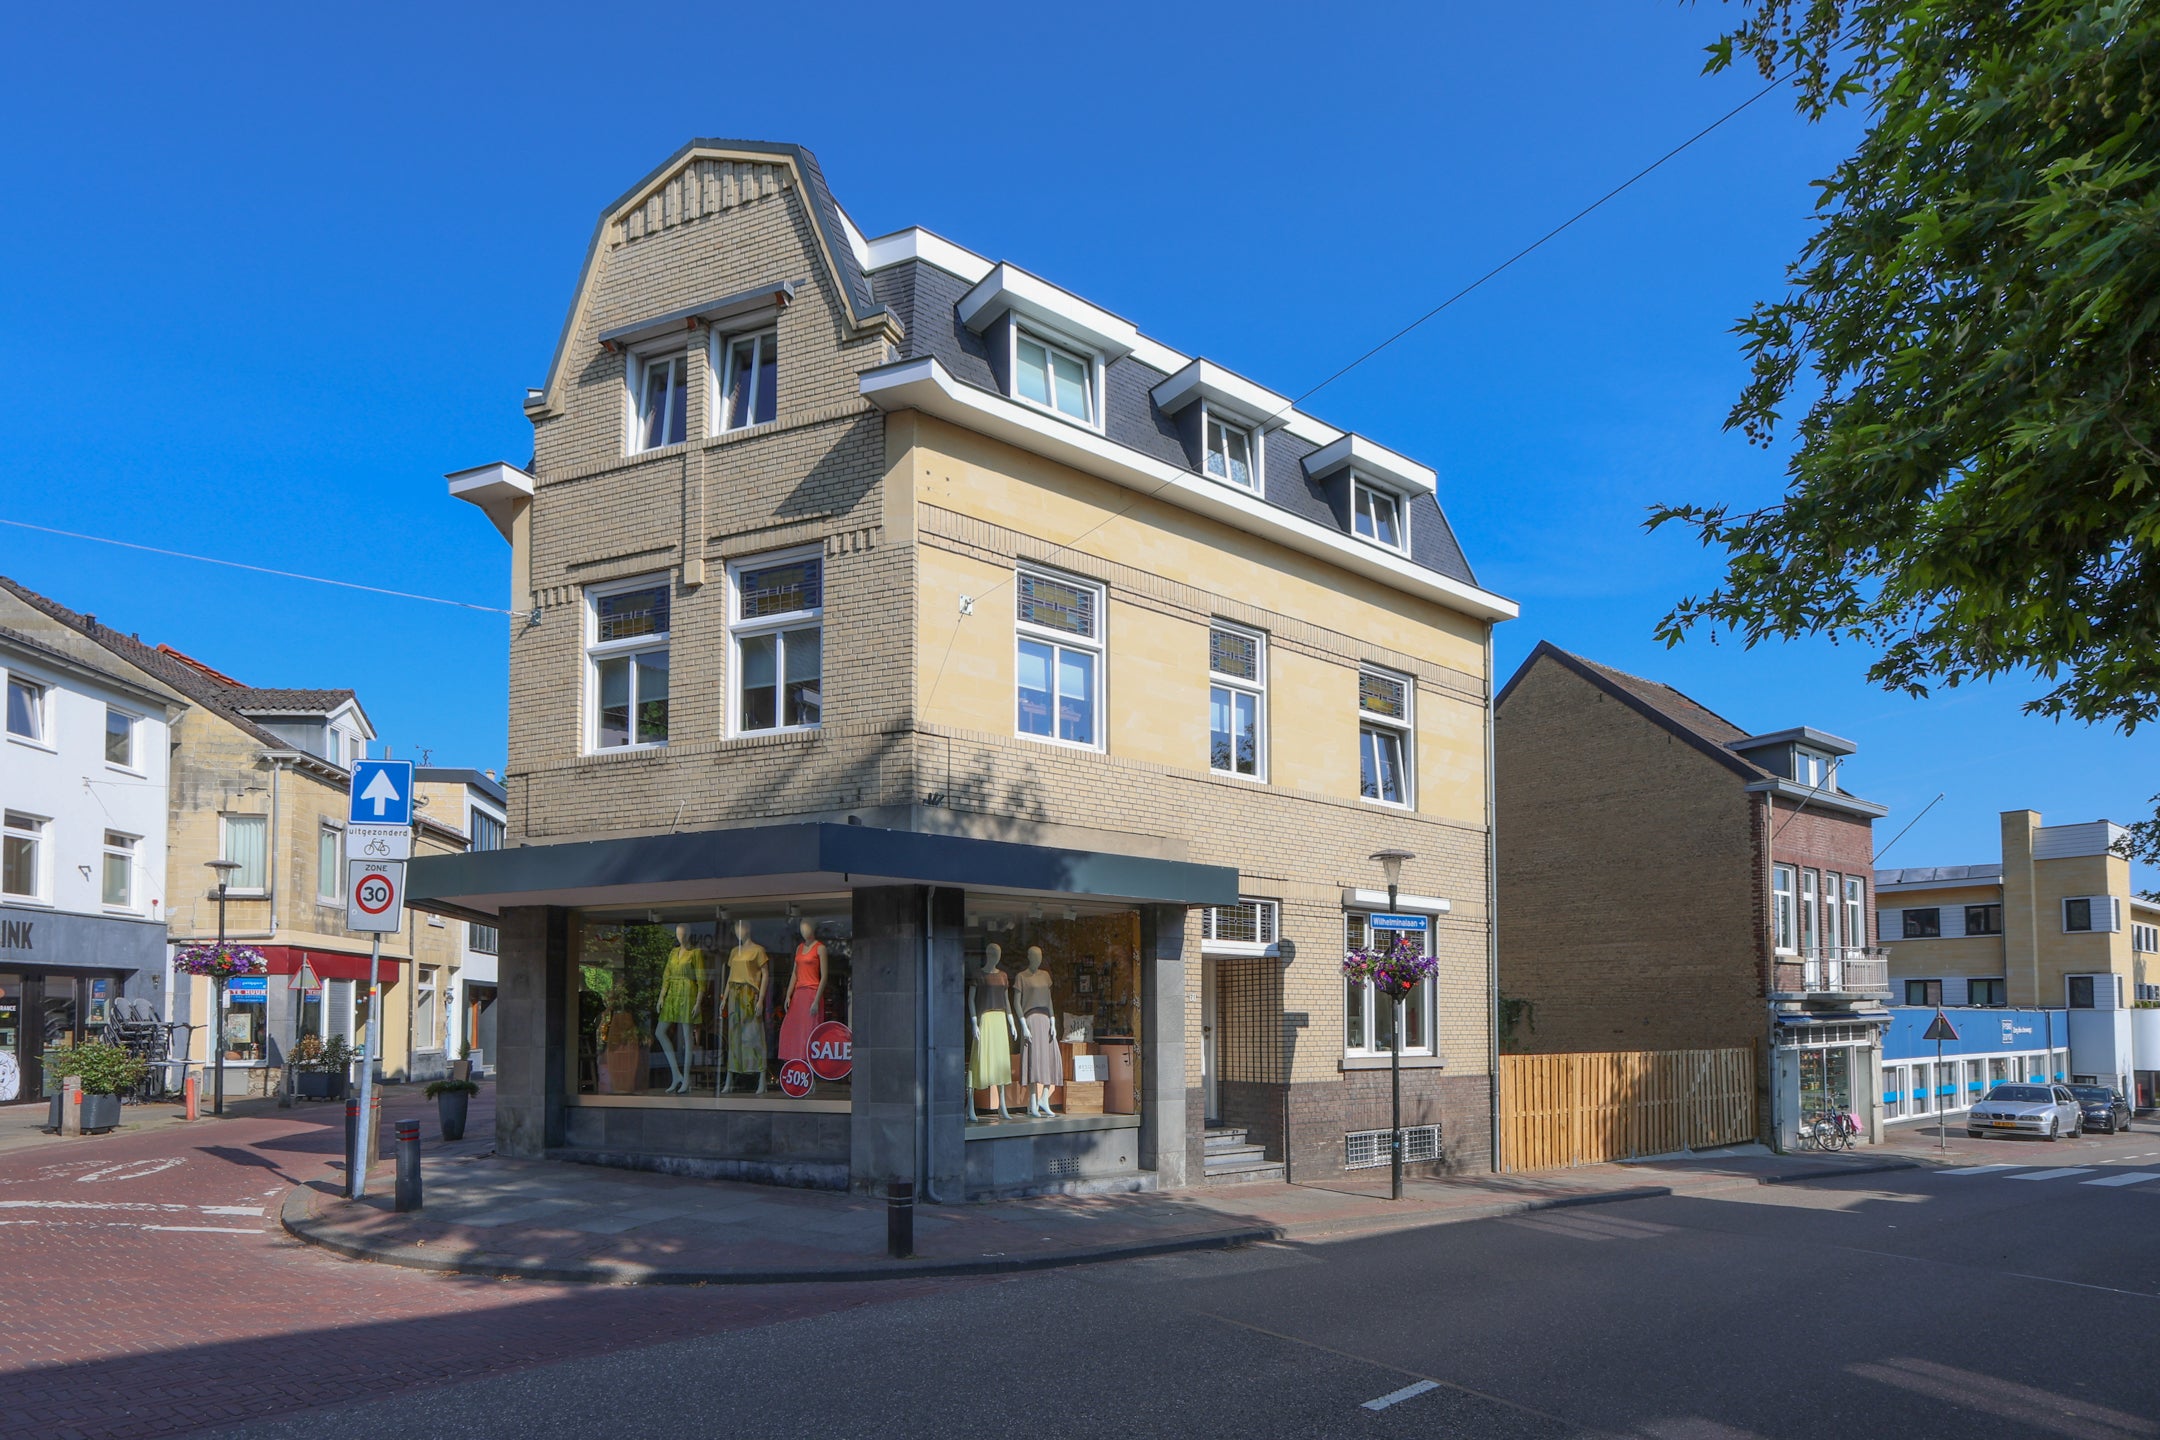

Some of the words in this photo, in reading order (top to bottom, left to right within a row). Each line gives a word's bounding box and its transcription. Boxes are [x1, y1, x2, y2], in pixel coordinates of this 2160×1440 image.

[349, 828, 408, 838] uitgezonderd
[365, 864, 388, 872] ZONE
[363, 886, 387, 903] 30
[1373, 917, 1418, 928] Wilhelminalaan
[1, 919, 34, 950] INK
[811, 1041, 853, 1060] SALE
[782, 1069, 810, 1088] -50%
